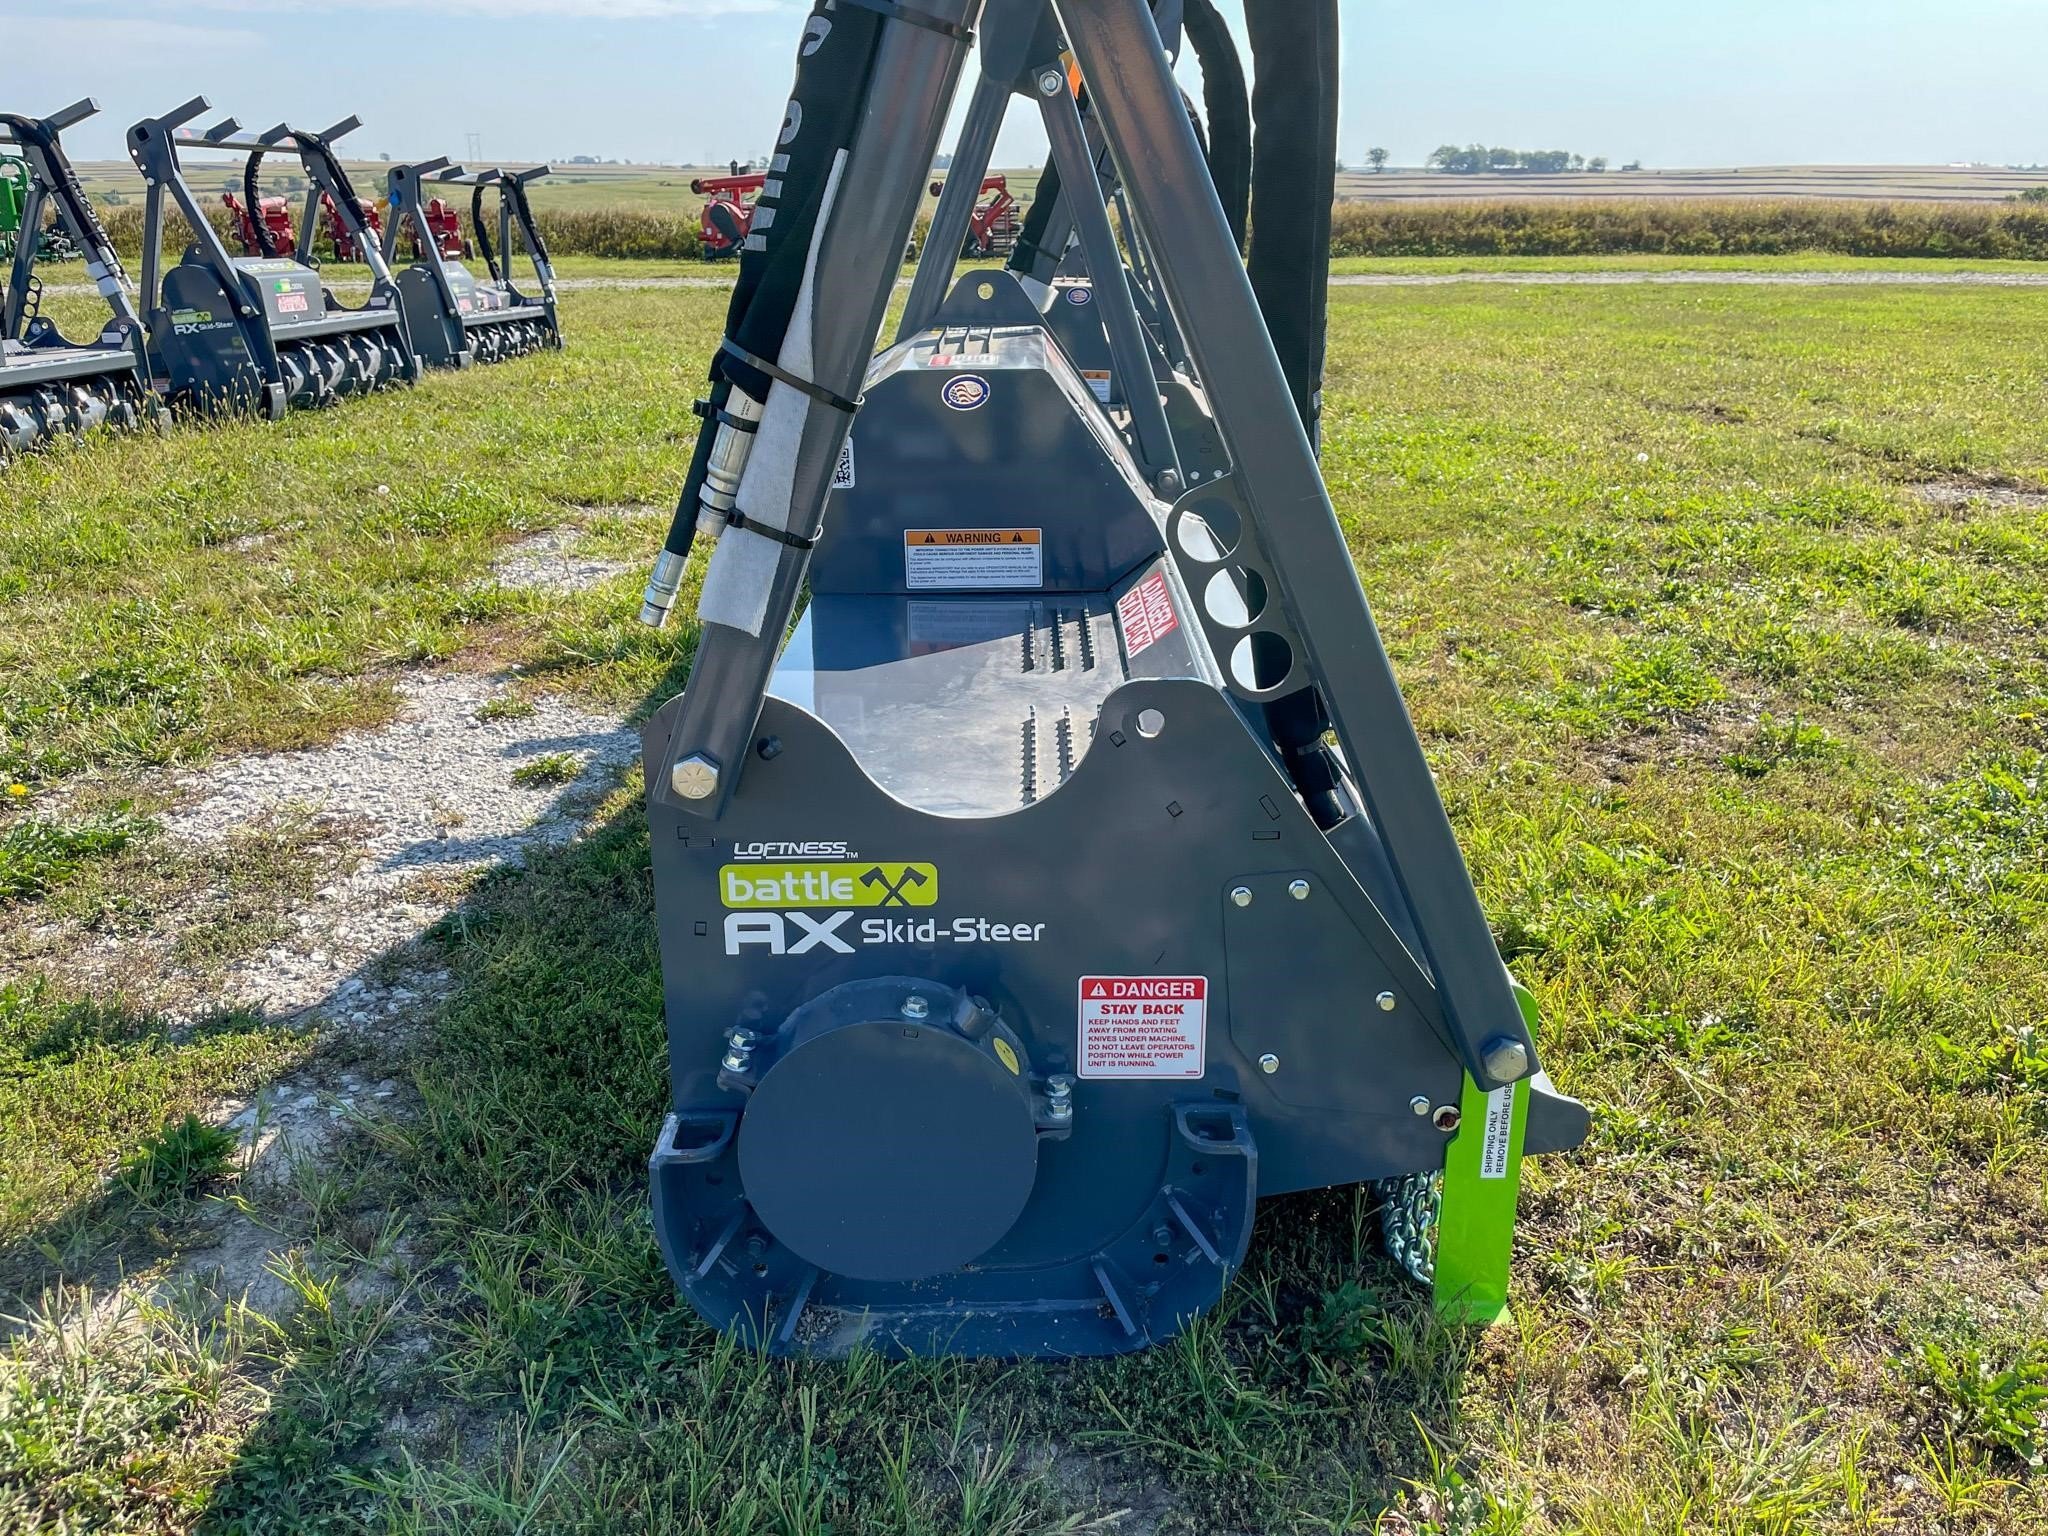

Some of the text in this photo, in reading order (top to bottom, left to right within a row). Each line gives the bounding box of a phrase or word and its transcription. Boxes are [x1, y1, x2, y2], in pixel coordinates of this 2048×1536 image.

[173, 323, 199, 335] AX
[946, 532, 1001, 543] WARNING
[1142, 581, 1173, 631] DANGER
[1119, 590, 1151, 656] STAY BACK
[733, 841, 848, 858] LOFTNESS
[726, 871, 854, 901] battle
[723, 911, 1046, 954] AX Skid-Steer
[1113, 982, 1195, 997] DANGER
[1100, 1004, 1184, 1015] STAY BACK
[1484, 1110, 1498, 1173] SHIPPING ONLY
[1495, 1082, 1513, 1173] REMOVE BEFORE USE
